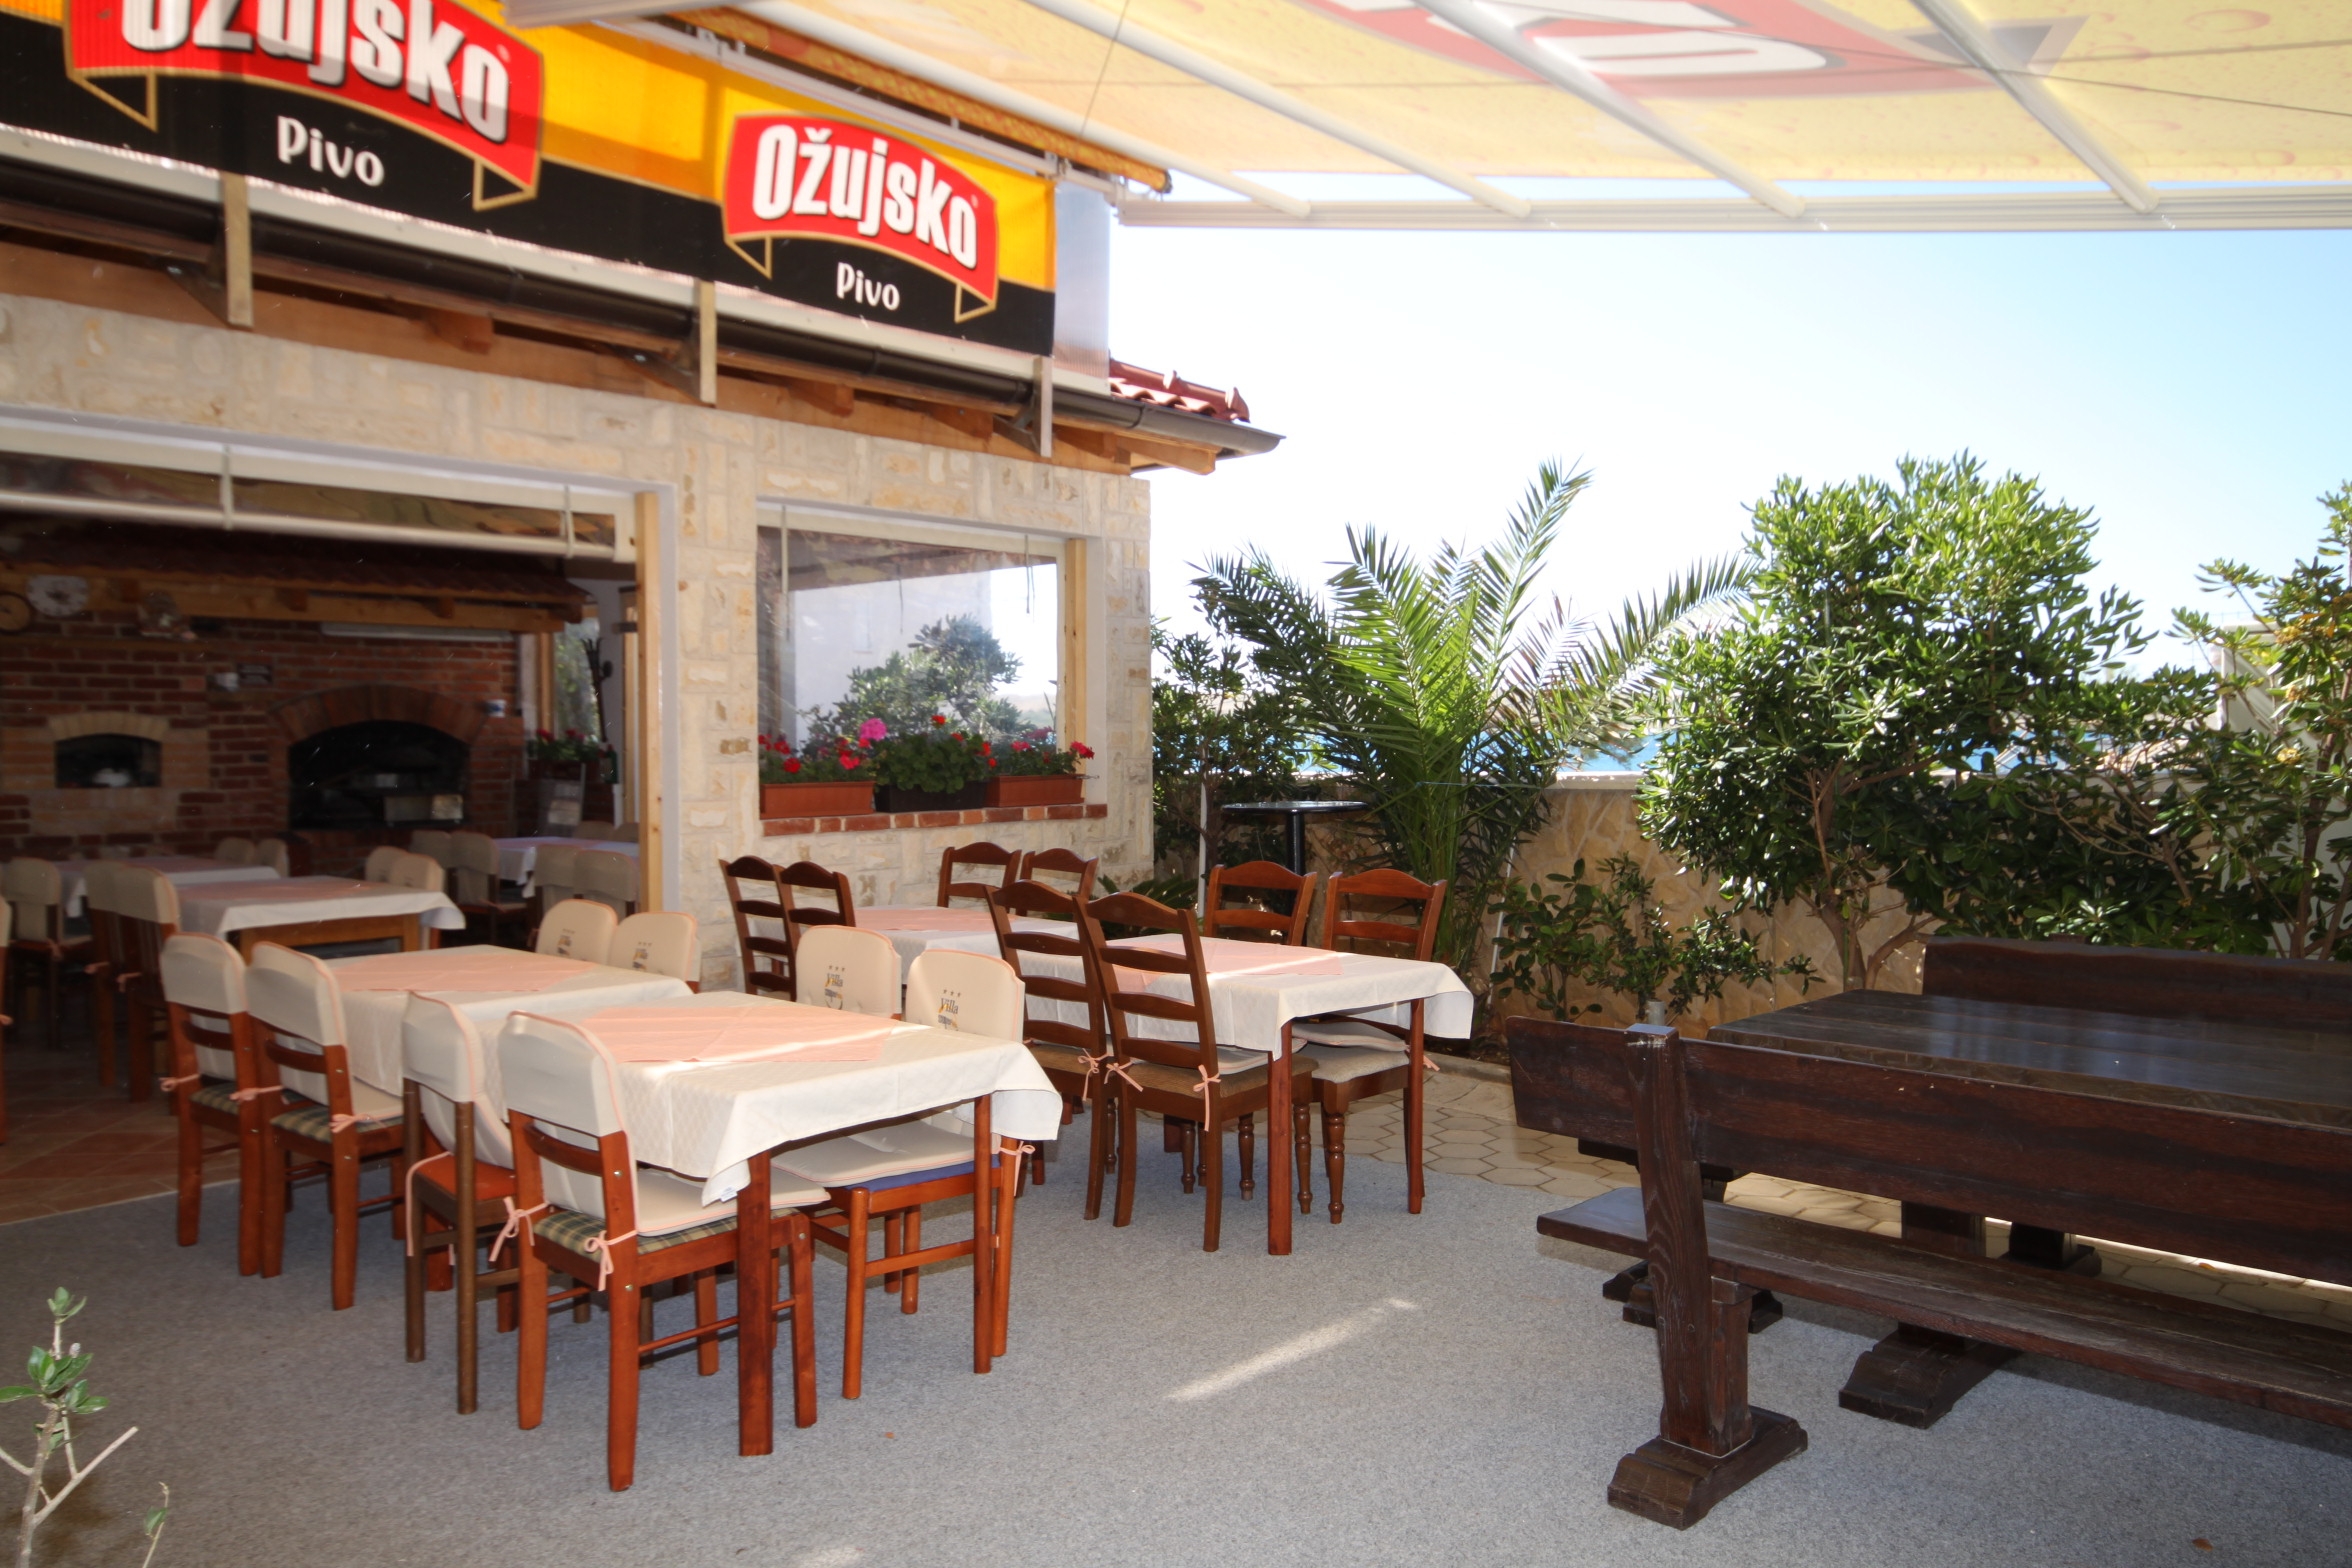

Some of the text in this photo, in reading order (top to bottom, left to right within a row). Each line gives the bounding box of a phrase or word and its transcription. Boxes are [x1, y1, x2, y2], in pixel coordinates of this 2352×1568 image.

[277, 115, 385, 187] Pivo
[752, 124, 977, 270] Ožujsko
[836, 262, 899, 311] Pivo
[939, 997, 959, 1015] Villa
